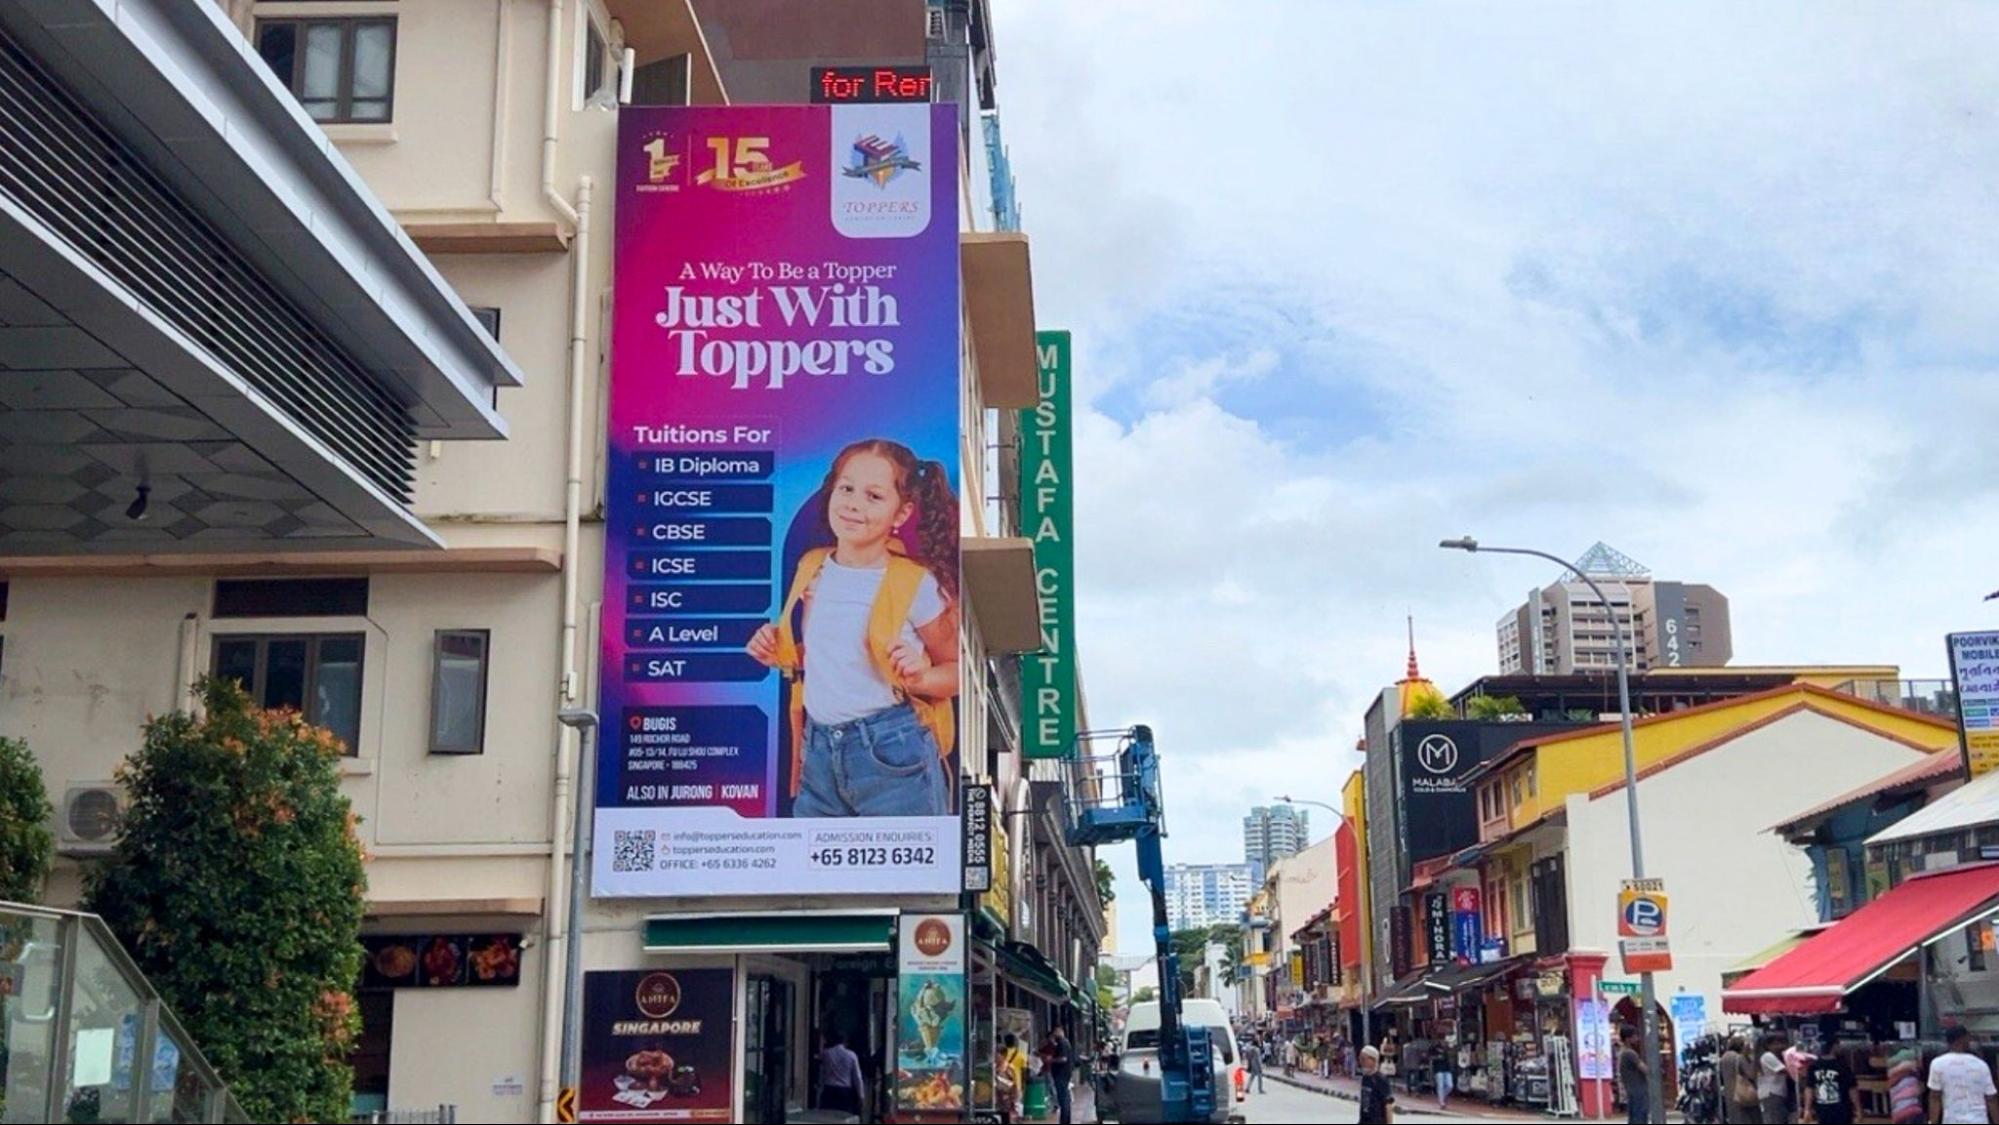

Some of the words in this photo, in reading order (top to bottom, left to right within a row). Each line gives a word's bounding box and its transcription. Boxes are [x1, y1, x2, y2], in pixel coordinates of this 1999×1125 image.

[821, 71, 865, 98] for
[707, 137, 770, 181] 15
[739, 170, 790, 187] Excellence
[844, 201, 919, 214] TOPPERS
[679, 262, 697, 280] A
[700, 262, 744, 284] Way
[748, 262, 773, 280] To
[778, 262, 804, 280] Be
[807, 267, 820, 280] a
[823, 262, 897, 283] Topper
[655, 285, 764, 329] Just
[768, 282, 900, 328] With
[668, 330, 896, 390] Toppers
[633, 424, 728, 444] Tuitions
[733, 426, 772, 444] For
[1036, 343, 1061, 544] MUSTAFA
[655, 457, 675, 473] IB
[679, 456, 760, 477] Diploma
[654, 490, 712, 507] IGCSE
[652, 523, 706, 540] CBSE
[651, 557, 696, 574] ICSE
[650, 591, 683, 608] ISC
[648, 625, 665, 642] A
[668, 624, 719, 642] Level
[1665, 618, 1681, 668] 642
[1036, 567, 1061, 746] CENTRE
[647, 660, 687, 677] SAT
[642, 716, 677, 731] BUGIS
[671, 733, 691, 743] ROAD
[707, 746, 739, 756] COMPLEX
[628, 759, 664, 771] SINGAPORE
[626, 785, 656, 801] ALSO
[657, 785, 669, 800] IN
[670, 784, 713, 800] JURONG
[721, 784, 759, 799] KOVAN
[672, 830, 802, 842] info@topperseducation.com
[815, 831, 874, 844] ADMISSION
[672, 844, 775, 856] topperseducation.com
[811, 848, 843, 865] +65
[847, 847, 887, 866] 8123
[892, 847, 935, 865] 6342
[660, 859, 697, 870] OFFICE:
[701, 859, 721, 870] +65
[723, 859, 749, 870] 6336
[751, 859, 777, 869] 4262
[612, 1020, 703, 1036] SINGAPORE
